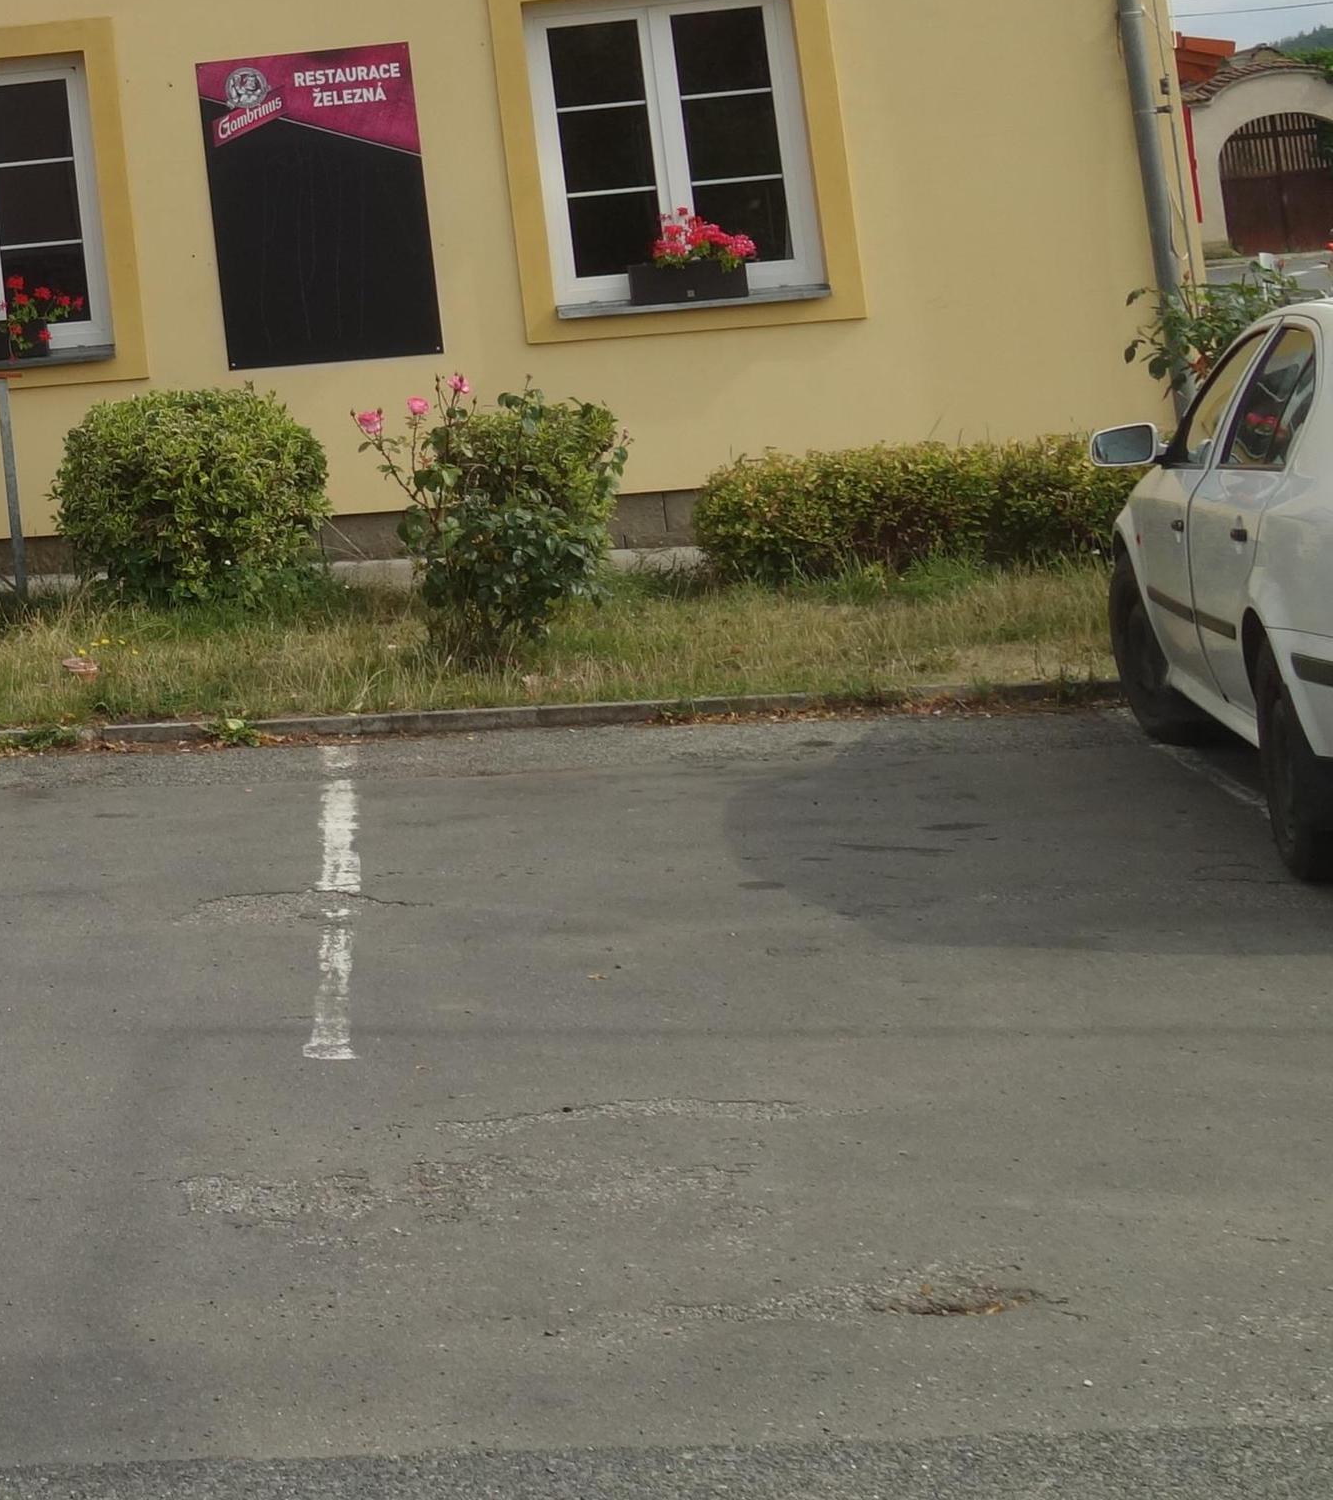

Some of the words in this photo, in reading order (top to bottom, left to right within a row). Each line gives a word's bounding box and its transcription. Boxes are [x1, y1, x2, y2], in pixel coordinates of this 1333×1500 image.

[294, 63, 401, 88] RESTAURACE
[312, 82, 387, 107] ŽELEZNÁ
[218, 97, 283, 139] Gambrinus
